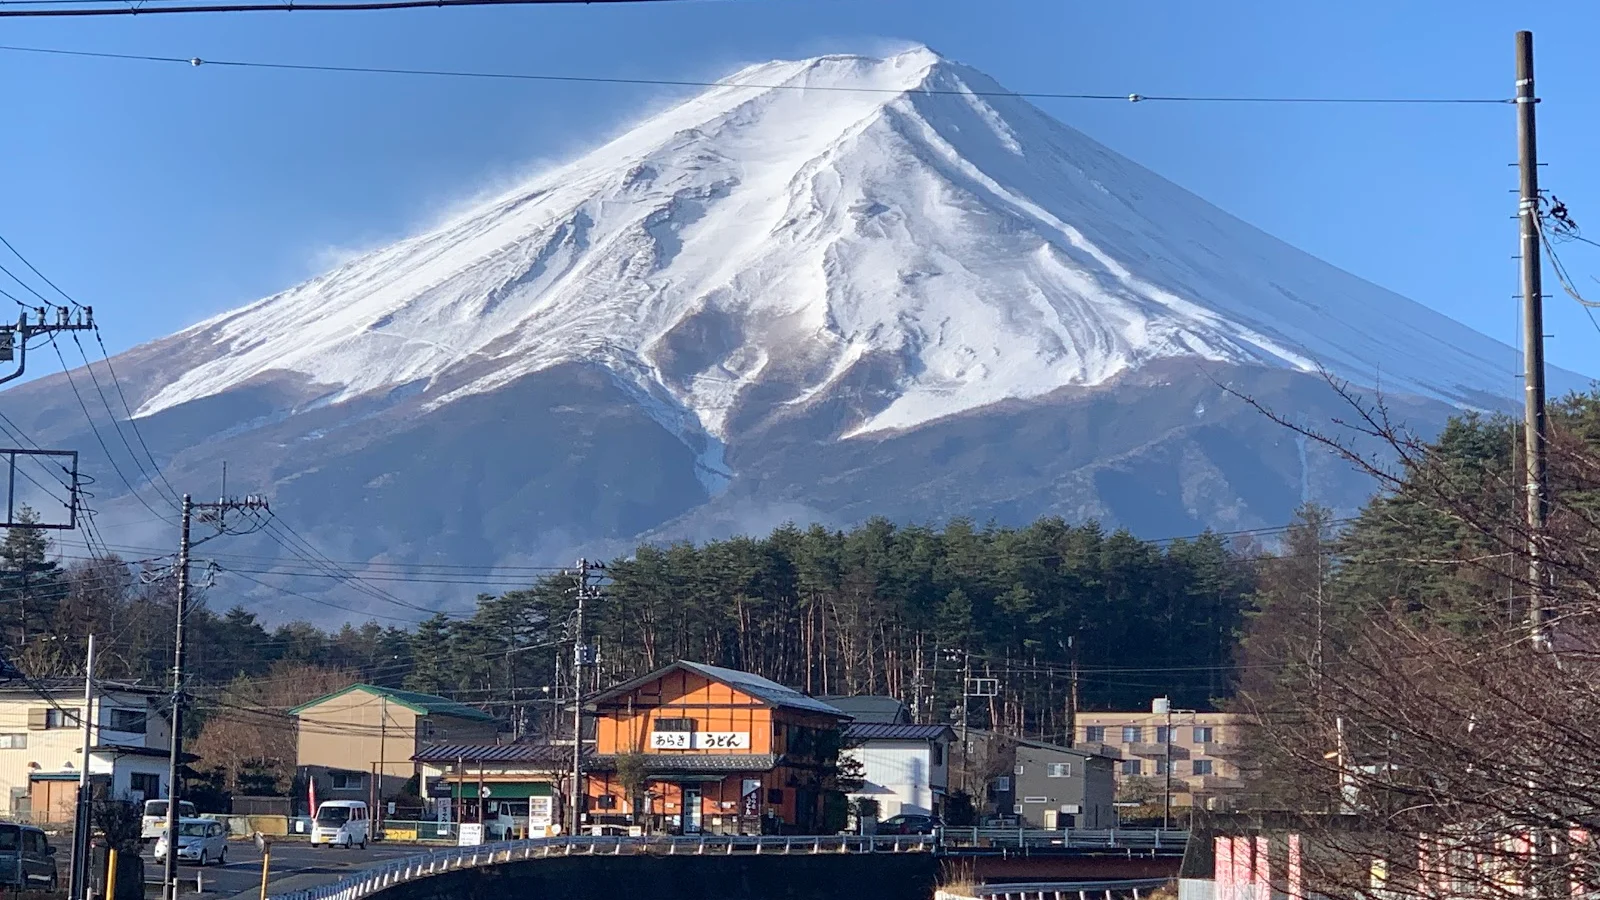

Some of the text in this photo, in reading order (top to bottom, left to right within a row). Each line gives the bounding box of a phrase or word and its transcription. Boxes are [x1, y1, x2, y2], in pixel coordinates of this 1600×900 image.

[655, 734, 686, 747] あらき
[705, 733, 740, 748] うどん
